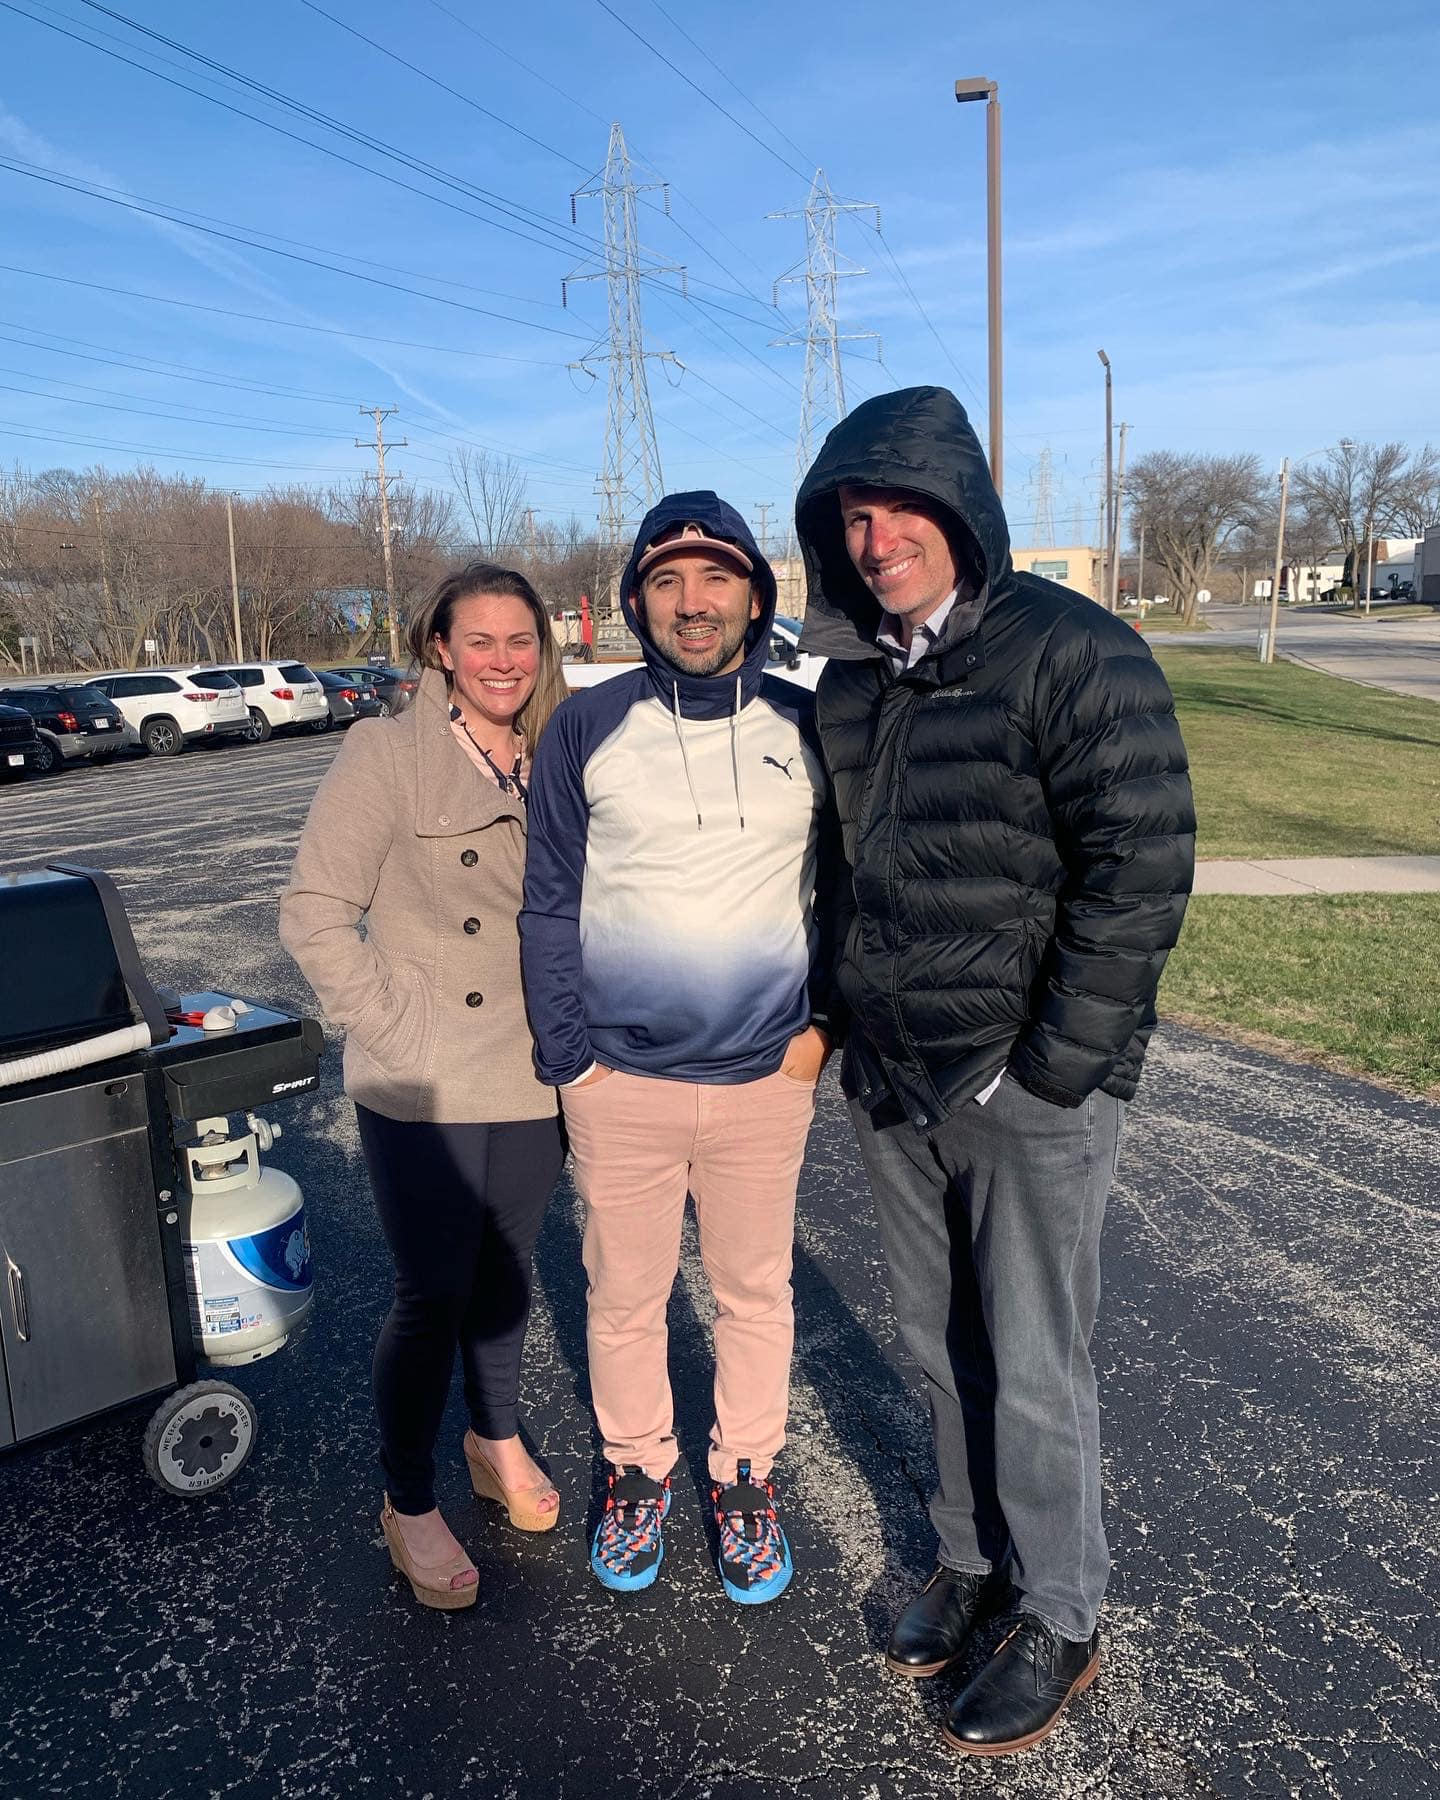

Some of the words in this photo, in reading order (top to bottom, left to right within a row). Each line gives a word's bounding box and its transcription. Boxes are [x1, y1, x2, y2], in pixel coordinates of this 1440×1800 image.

[229, 1400, 250, 1429] WEBER
[162, 1414, 185, 1452] WEBER
[188, 1472, 225, 1488] WEBER
